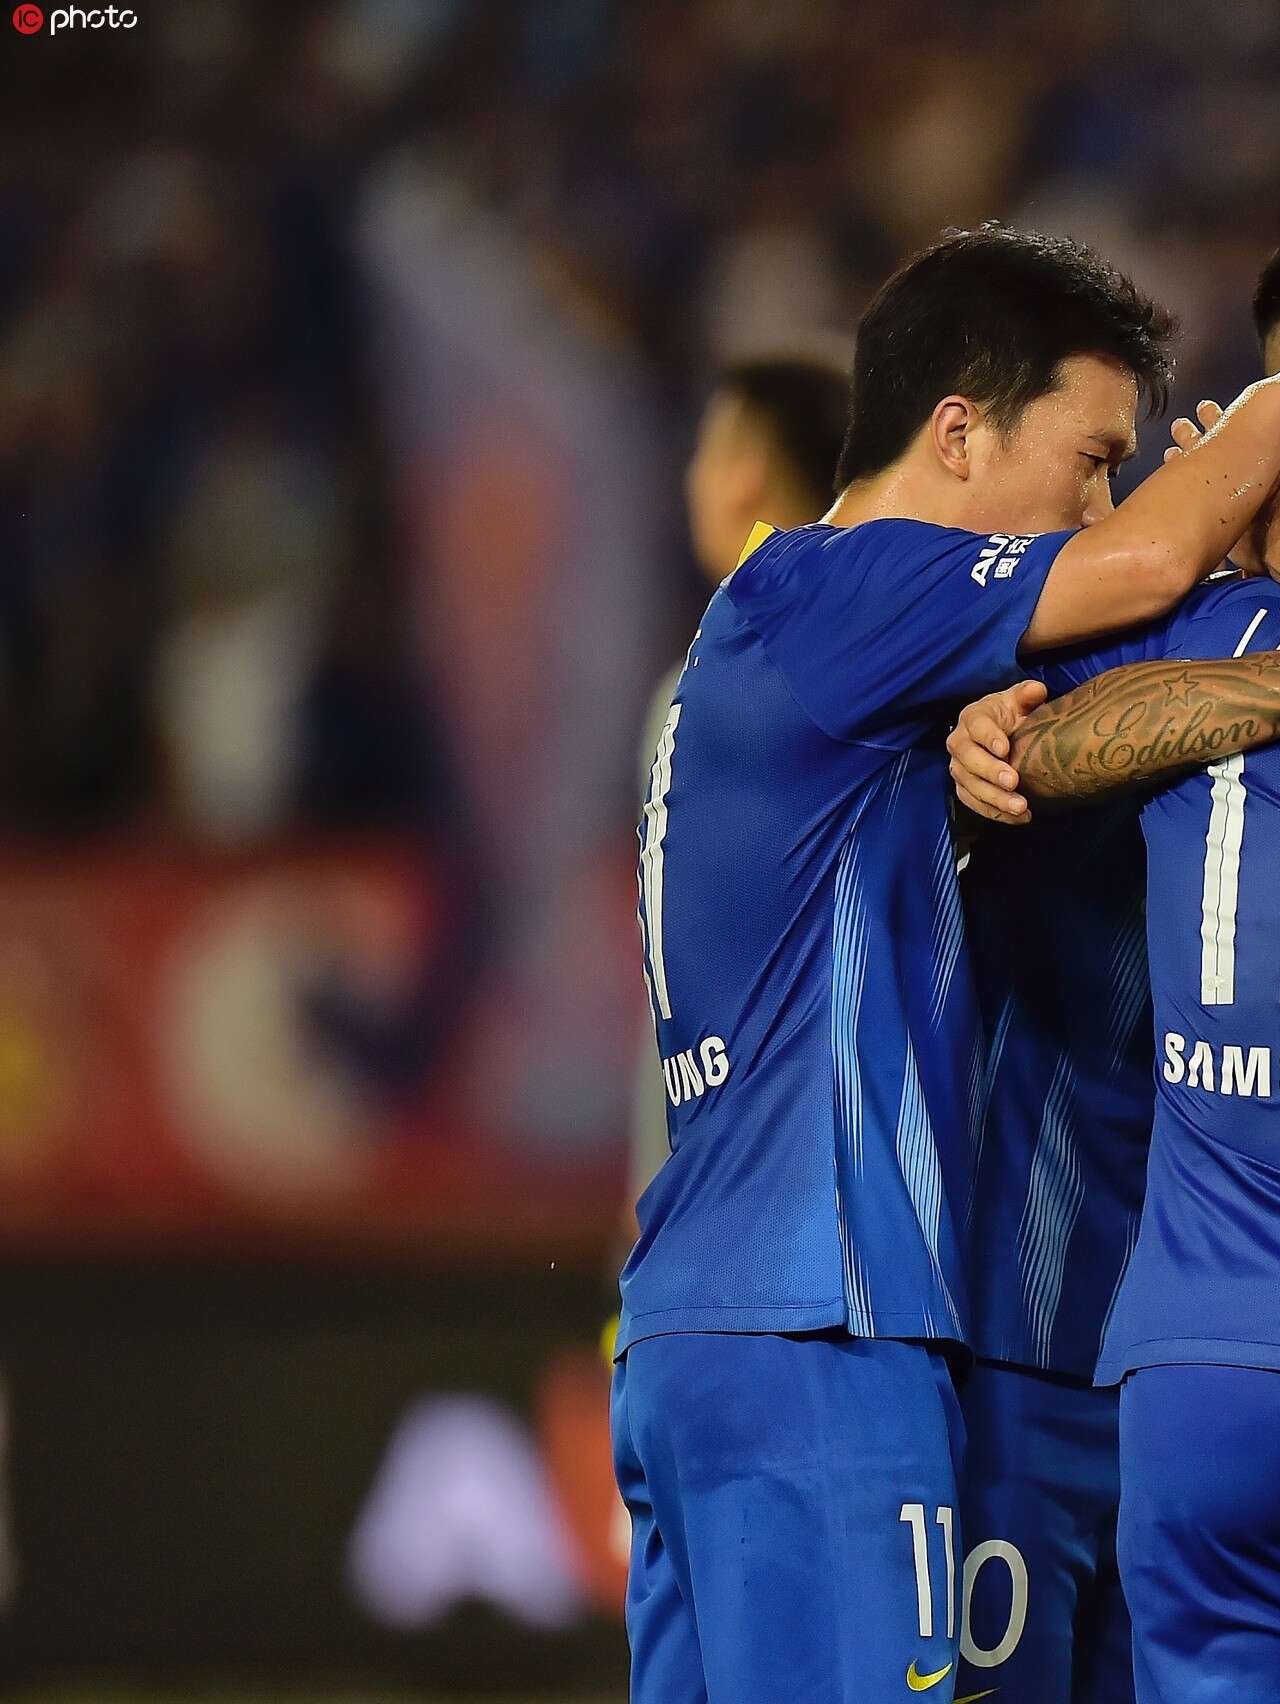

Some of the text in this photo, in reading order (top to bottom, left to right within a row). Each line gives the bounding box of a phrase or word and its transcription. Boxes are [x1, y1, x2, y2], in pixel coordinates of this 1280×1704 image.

[971, 534, 1016, 588] AU
[1087, 701, 1260, 772] Edilson
[899, 1503, 955, 1638] 11
